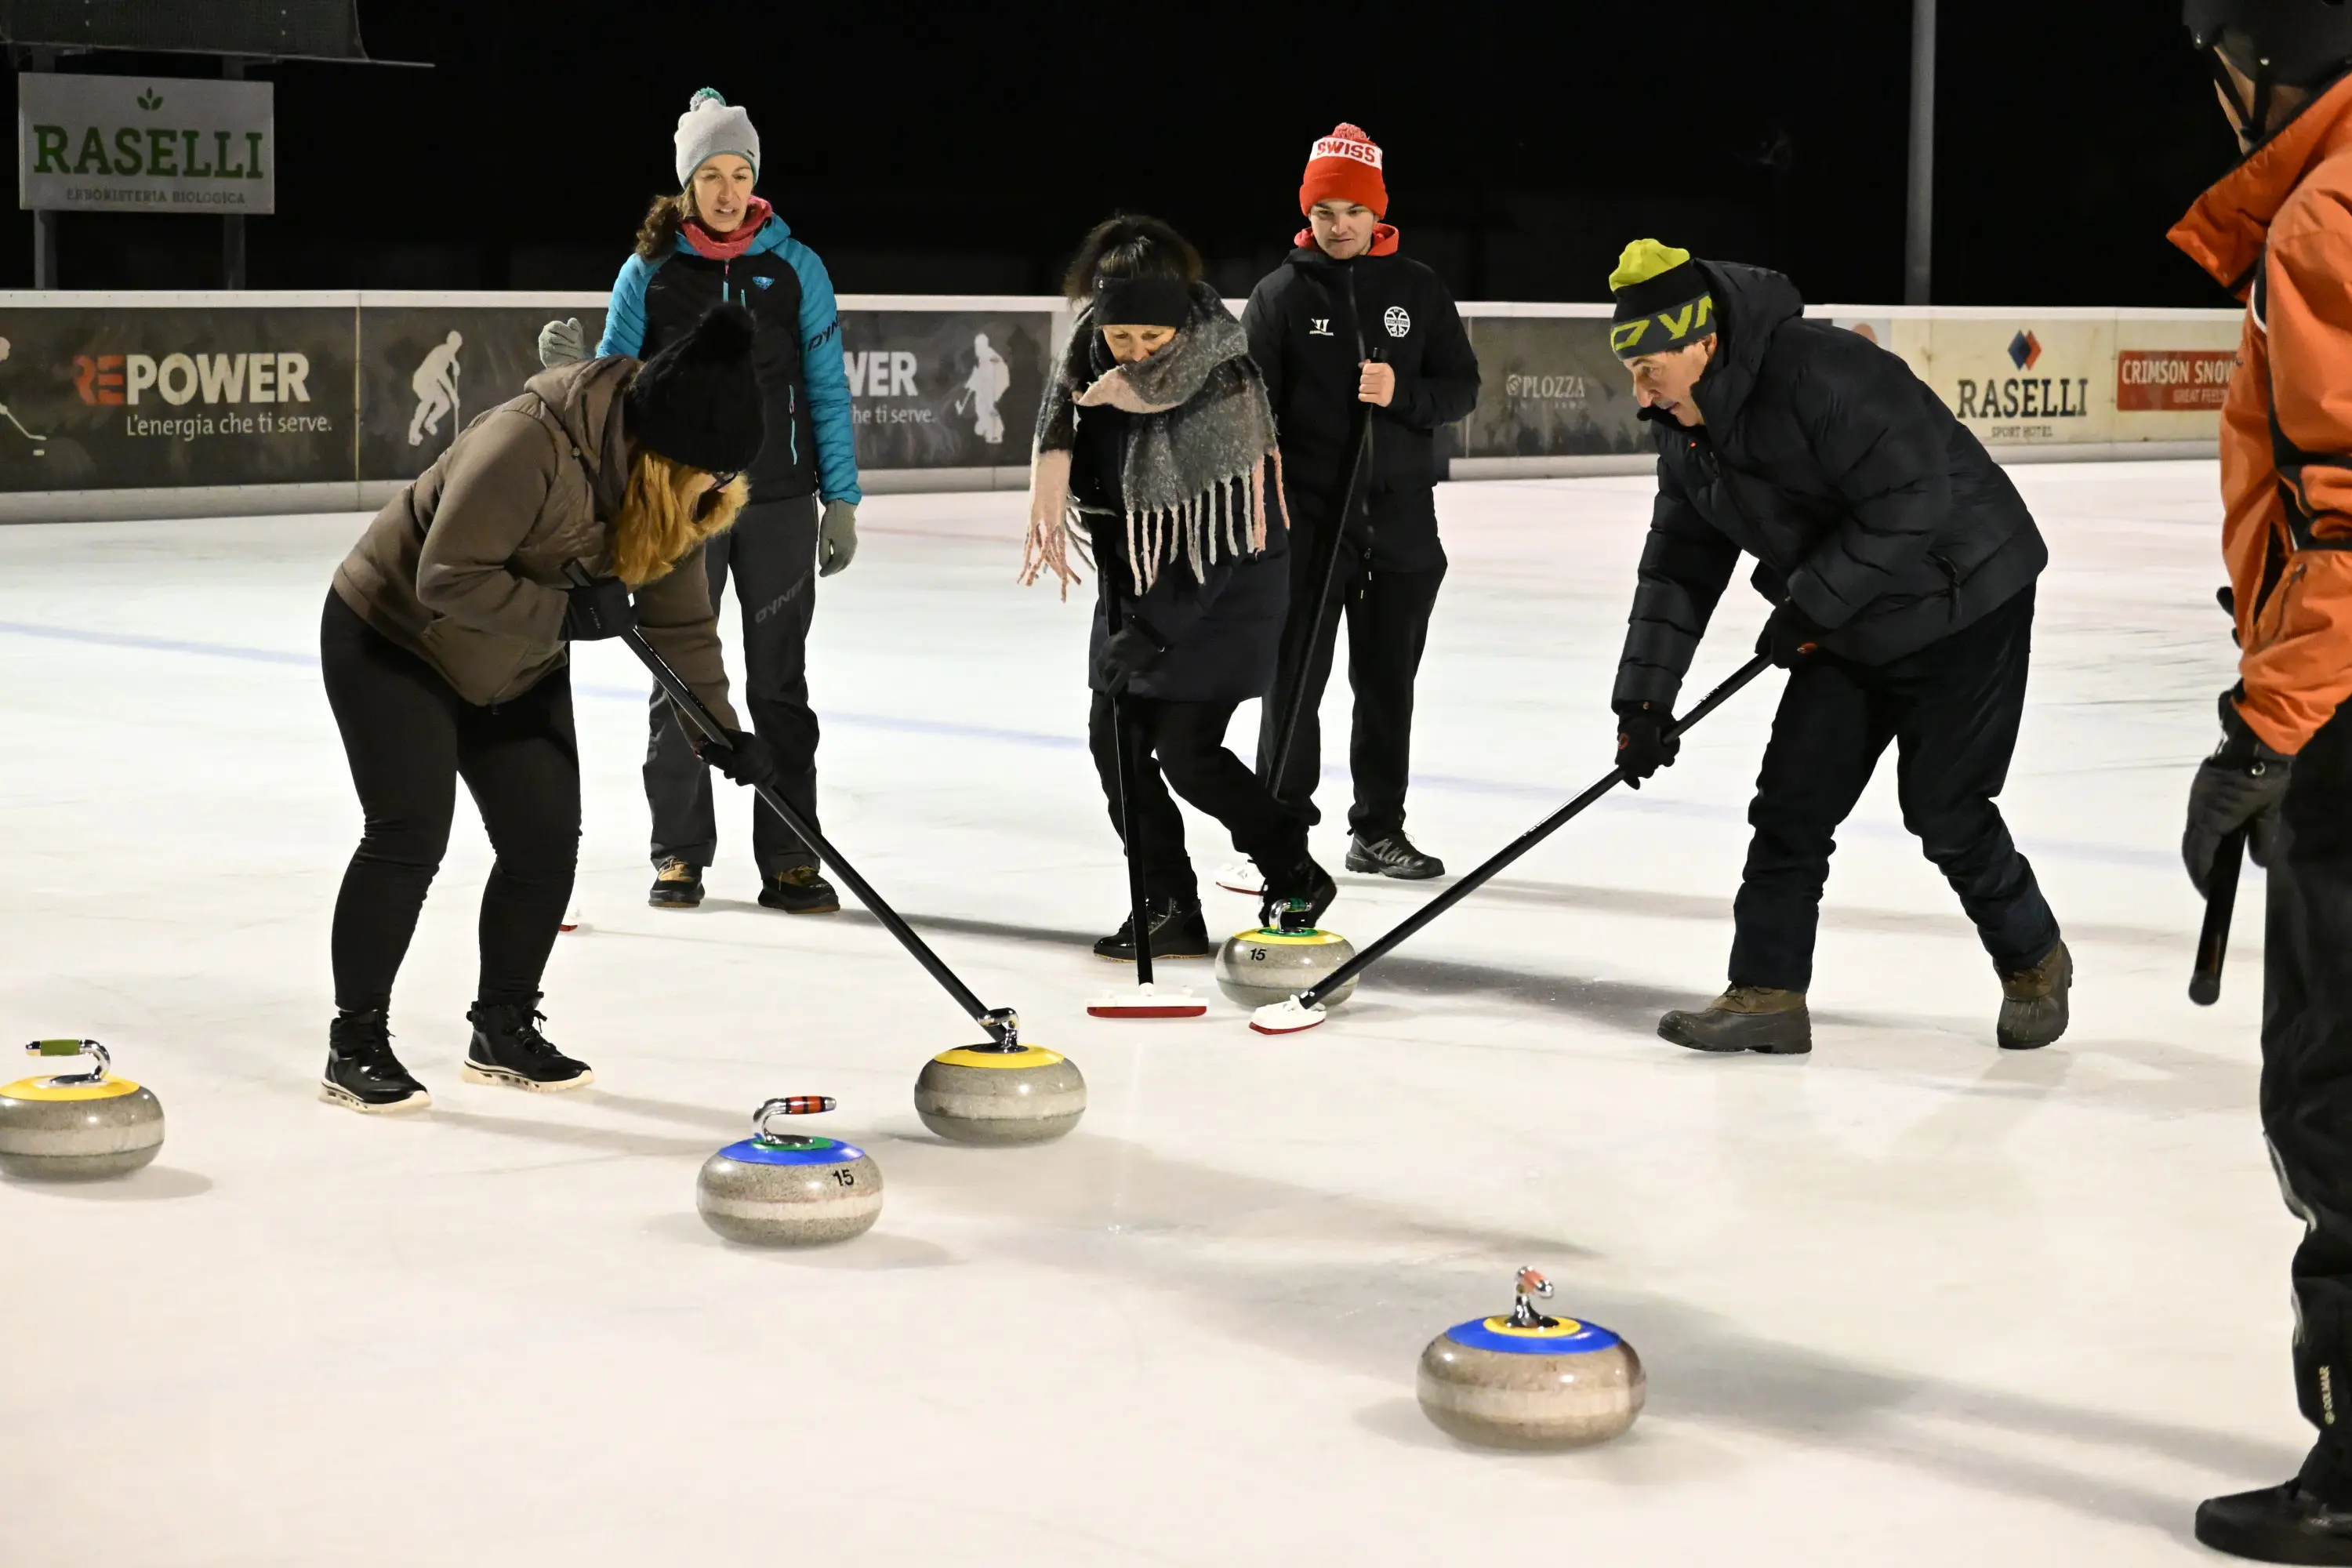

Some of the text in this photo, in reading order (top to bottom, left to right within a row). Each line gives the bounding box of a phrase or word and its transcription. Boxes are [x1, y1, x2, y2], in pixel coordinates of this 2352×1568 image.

[33, 125, 263, 179] RASELLI
[1317, 141, 1375, 163] SWISS
[66, 188, 245, 204] ERBORISTERIA BIOLOGICA
[73, 352, 311, 406] REPOWER
[2122, 359, 2190, 384] CRIMSON
[1523, 376, 1585, 398] PLOZZA
[1957, 379, 2088, 418] RASELLI
[220, 412, 253, 434] che
[258, 413, 272, 433] ti
[278, 416, 332, 433] serve.
[852, 407, 872, 424] he
[875, 404, 887, 423] ti
[1991, 426, 2053, 438] SPORT HOTEL
[1250, 948, 1266, 960] 15
[833, 1169, 855, 1186] 15
